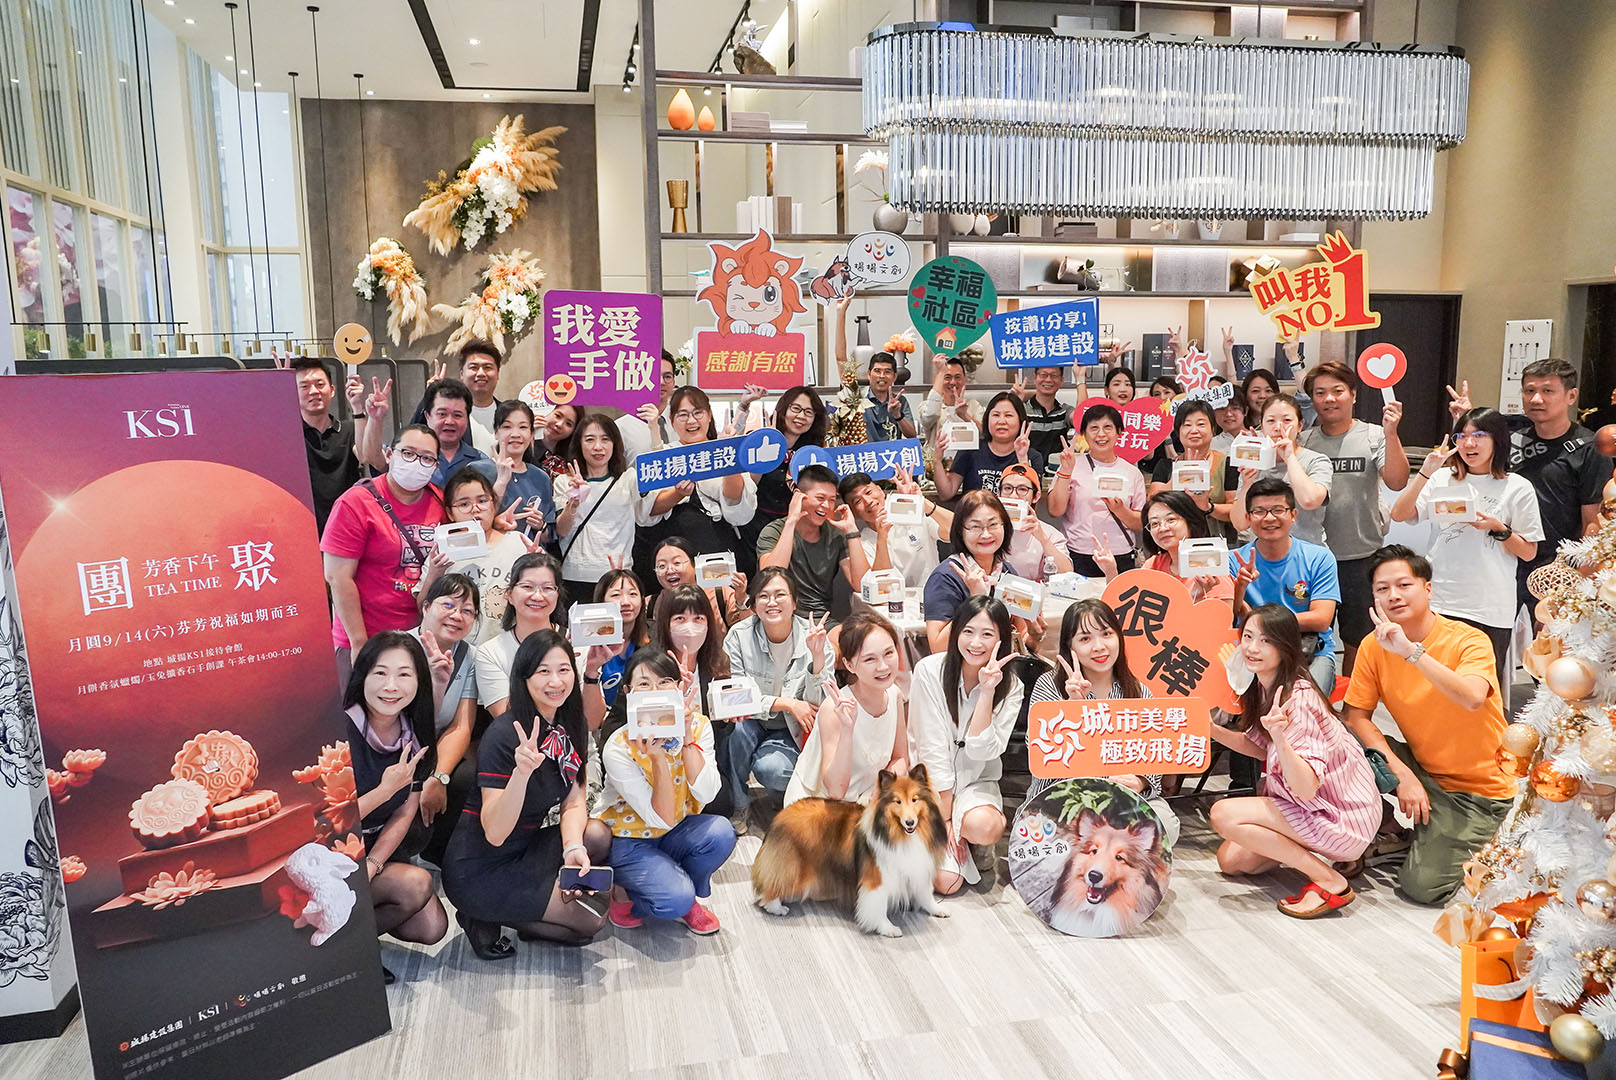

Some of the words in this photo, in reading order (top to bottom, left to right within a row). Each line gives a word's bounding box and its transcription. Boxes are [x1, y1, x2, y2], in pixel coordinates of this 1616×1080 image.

[927, 265, 985, 299] 幸福
[1253, 267, 1332, 311] 叫我
[551, 303, 642, 348] 我愛
[921, 294, 979, 330] 社區
[705, 350, 798, 373] 感謝有您
[1000, 331, 1095, 361] 城揚建設
[567, 349, 656, 392] 手做
[639, 445, 737, 483] 城揚建設
[836, 445, 921, 477] 揚揚文創
[1350, 459, 1361, 470] IN
[76, 556, 134, 616] 團
[227, 541, 279, 592] 聚
[141, 553, 219, 579] 芳香下午
[143, 583, 179, 598] TEA
[180, 576, 222, 592] TIME
[1113, 585, 1211, 697] 很棒
[143, 654, 164, 668] 地點
[1081, 702, 1188, 736] 城市美學
[1100, 733, 1207, 768] 極致飛揚
